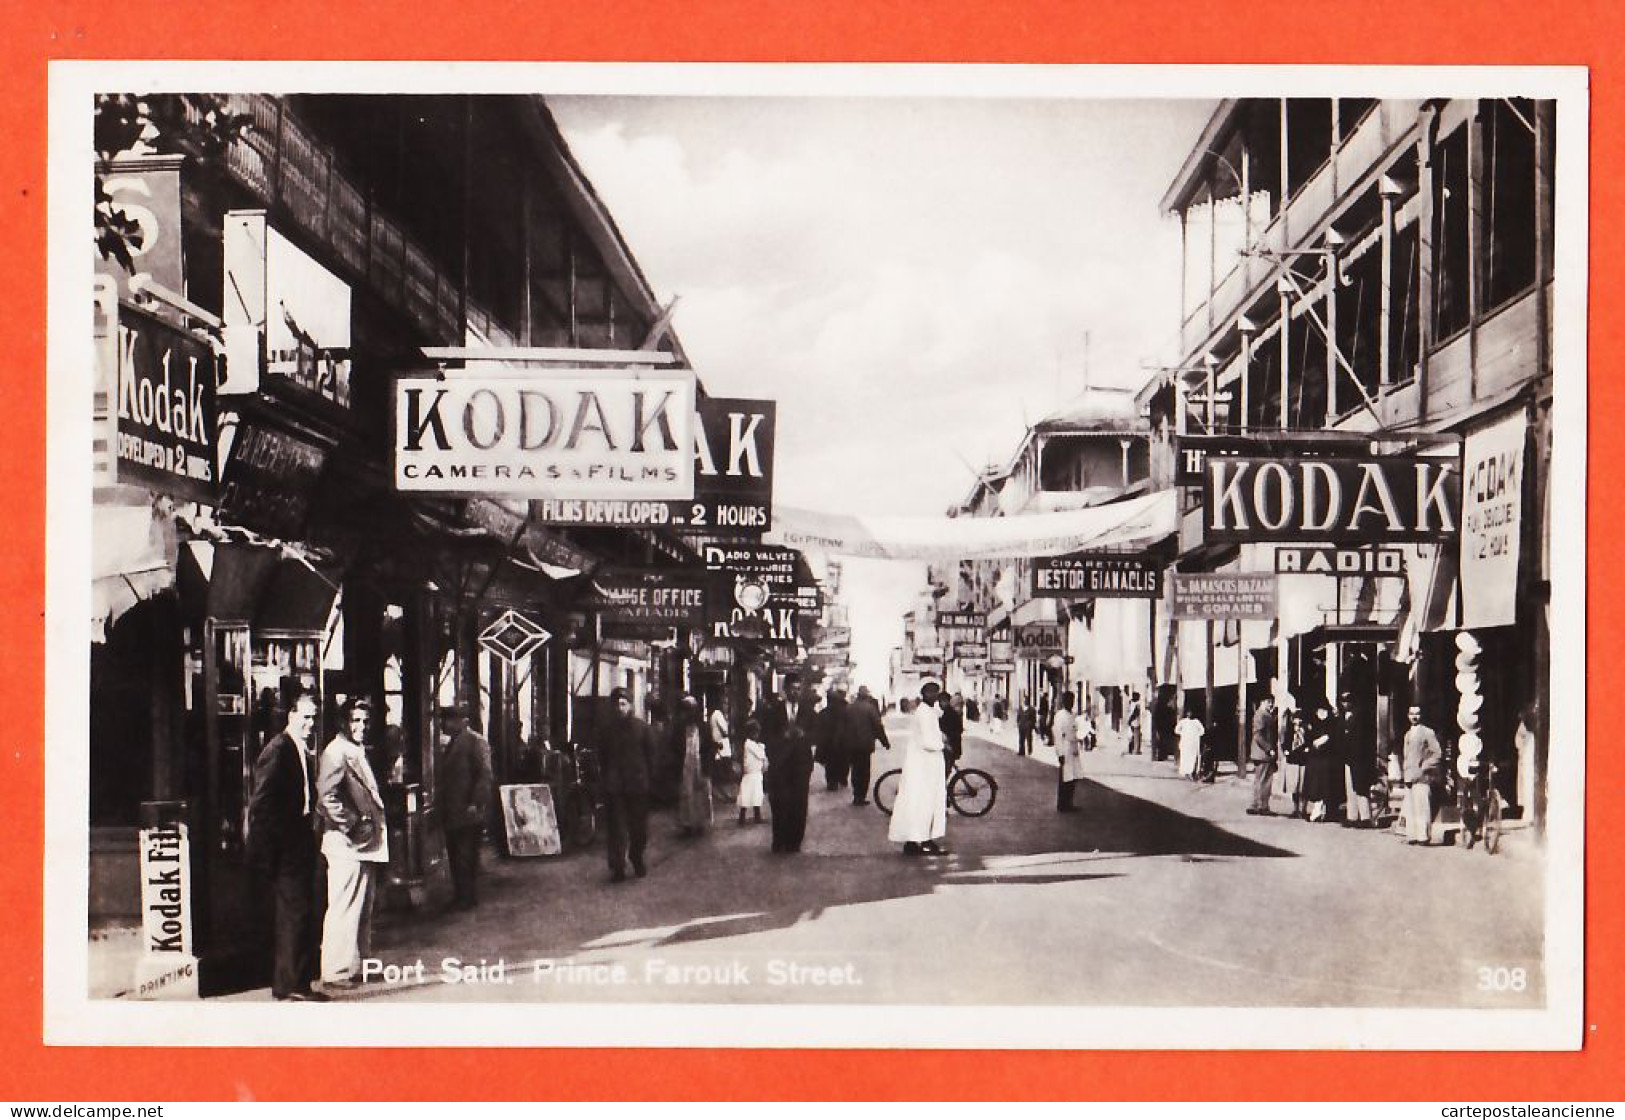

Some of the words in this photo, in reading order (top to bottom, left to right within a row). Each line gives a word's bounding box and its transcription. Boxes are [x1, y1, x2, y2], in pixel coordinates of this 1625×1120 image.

[118, 325, 208, 445] Kodak
[403, 388, 679, 453] KODAK
[175, 444, 186, 475] 2
[404, 464, 561, 480] CAMERAS
[588, 464, 678, 482] FILMS
[1210, 461, 1456, 531] KODAK
[542, 500, 583, 522] FILMS
[586, 501, 669, 525] DEVELOPED
[690, 504, 706, 526] 2
[717, 505, 767, 527] HOURS
[756, 551, 795, 561] VALVES
[1051, 560, 1143, 570] CIGARETTES
[1279, 551, 1402, 572] RADIO
[1036, 569, 1085, 591] NESTOR
[1090, 569, 1156, 592] GIANACLIS
[653, 588, 703, 607] OFFICE
[1013, 626, 1063, 648] Kodak
[148, 867, 184, 953] Kodak
[140, 964, 193, 995] PRINTING
